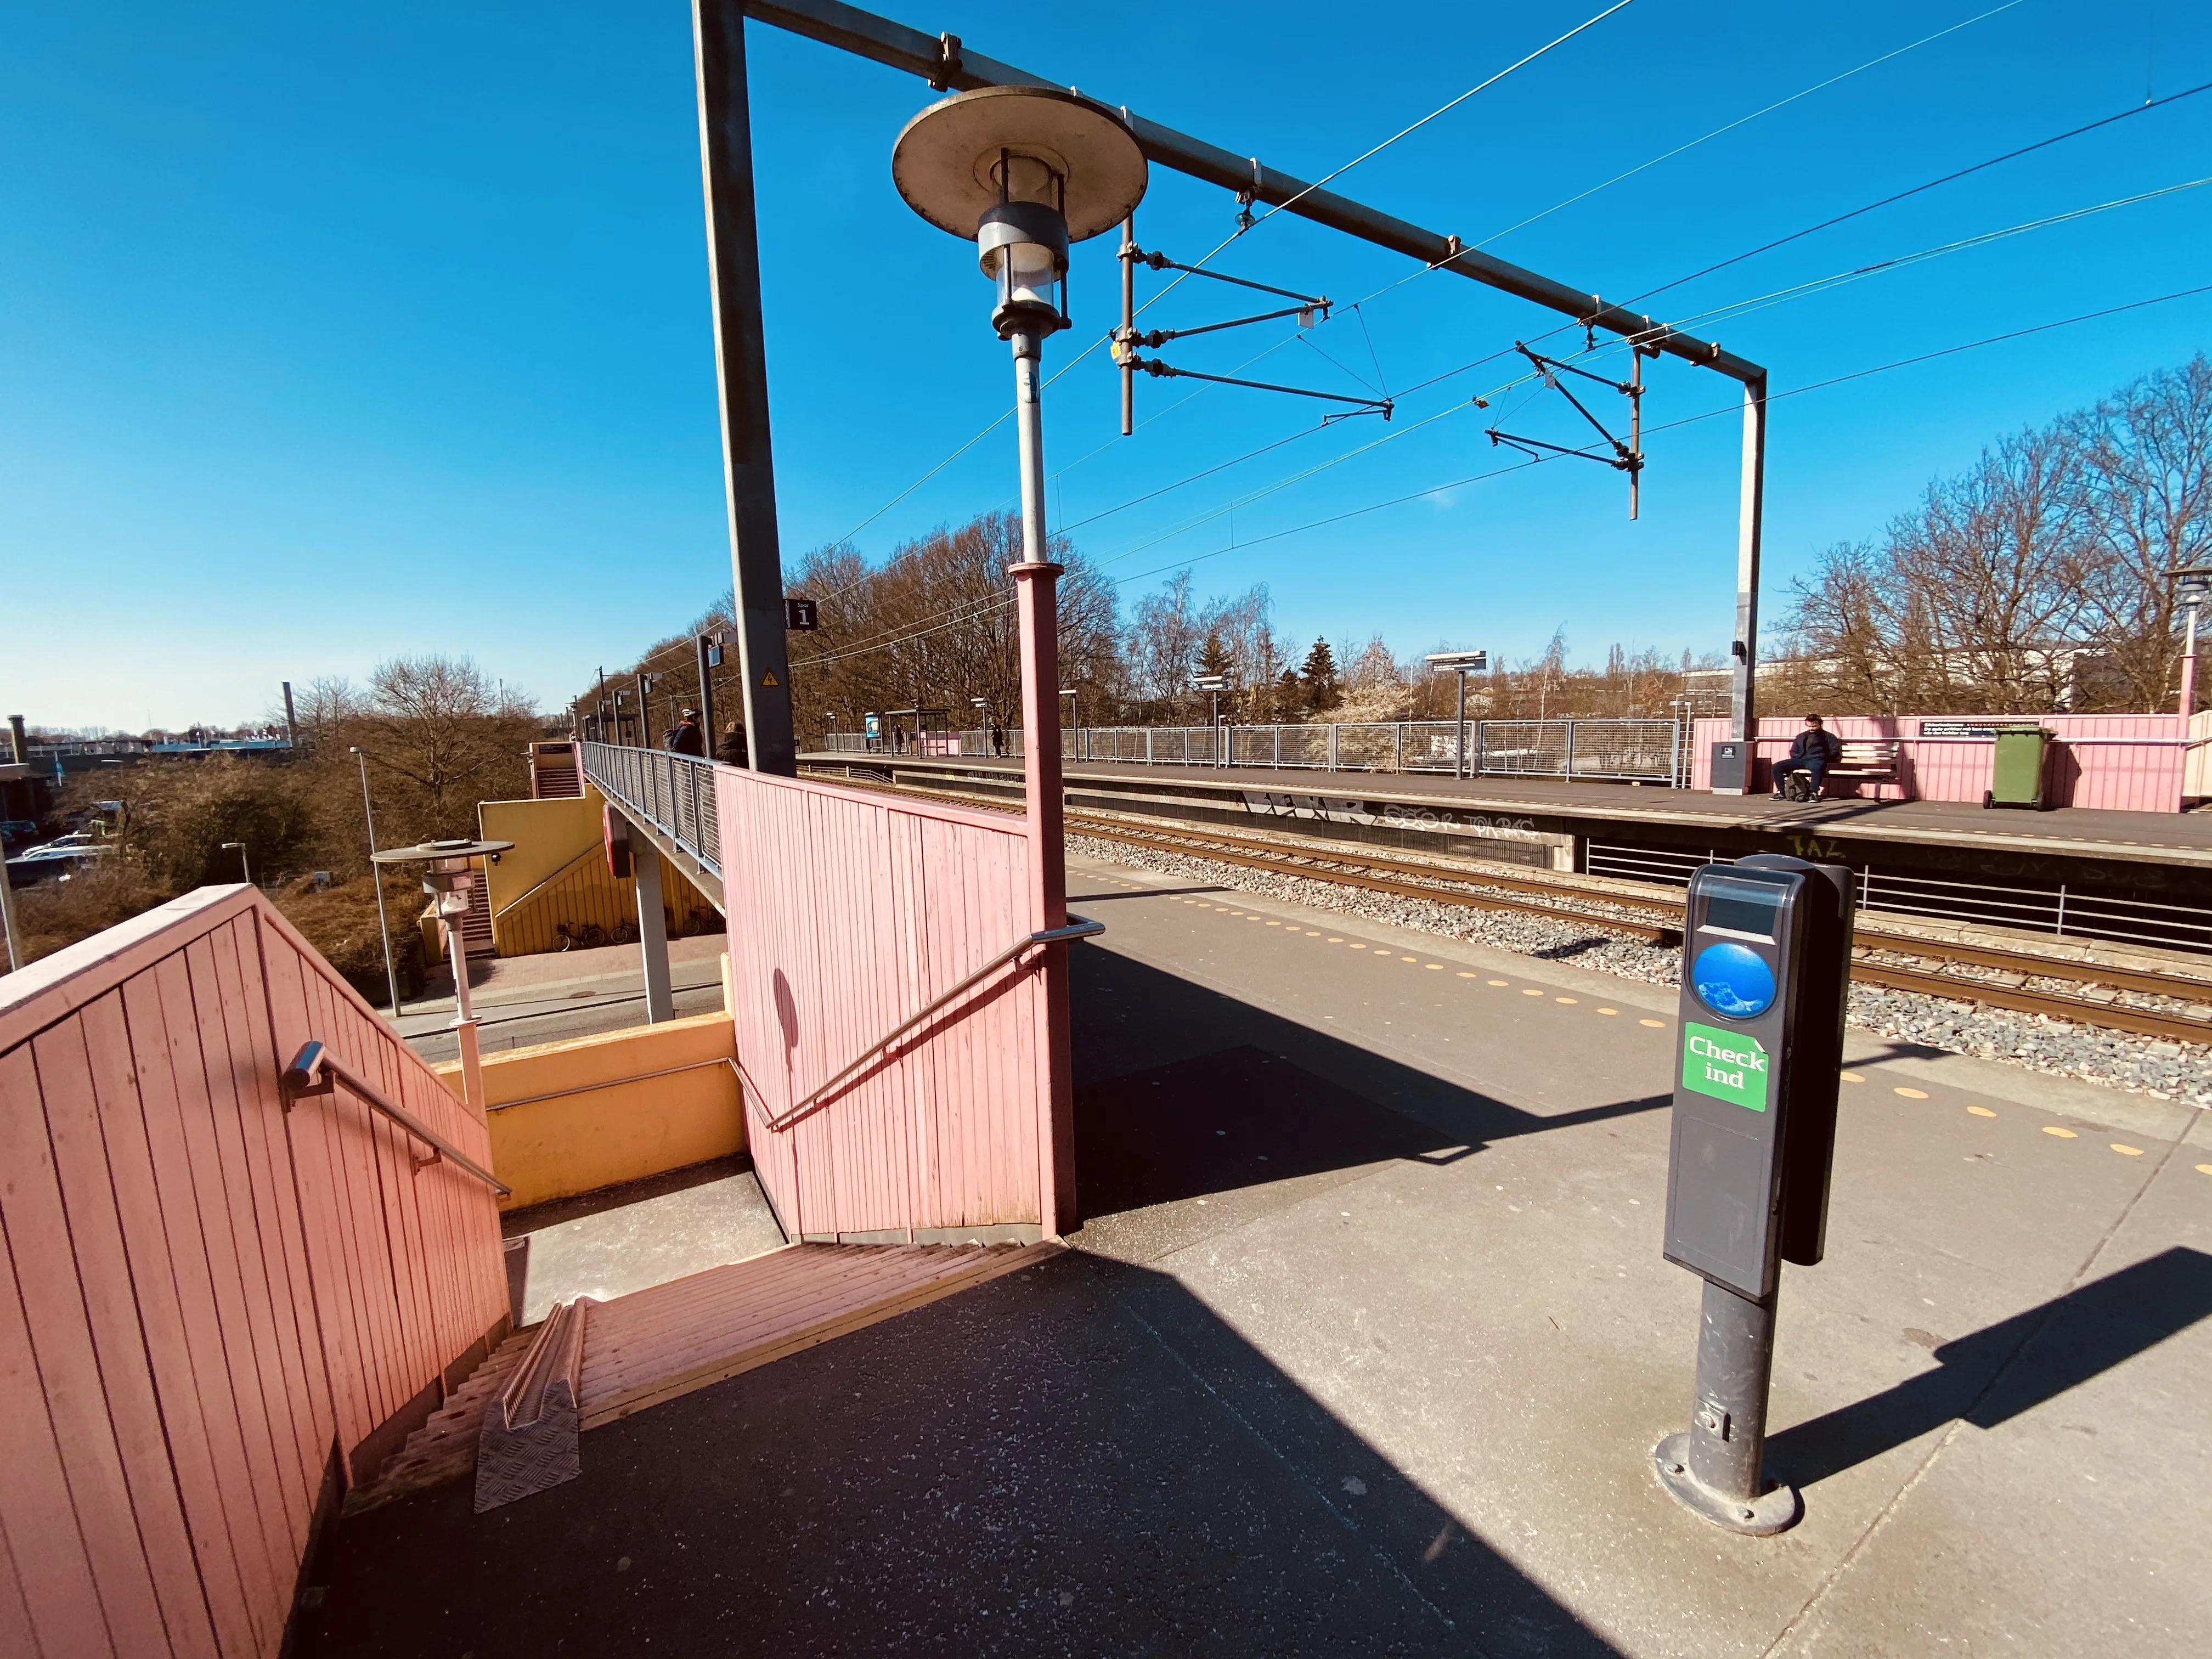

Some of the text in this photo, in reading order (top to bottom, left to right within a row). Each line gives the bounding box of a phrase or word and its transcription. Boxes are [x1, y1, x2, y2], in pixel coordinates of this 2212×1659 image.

[799, 610, 810, 625] 1
[1689, 1036, 1765, 1072] Check
[1705, 1062, 1745, 1090] ind
